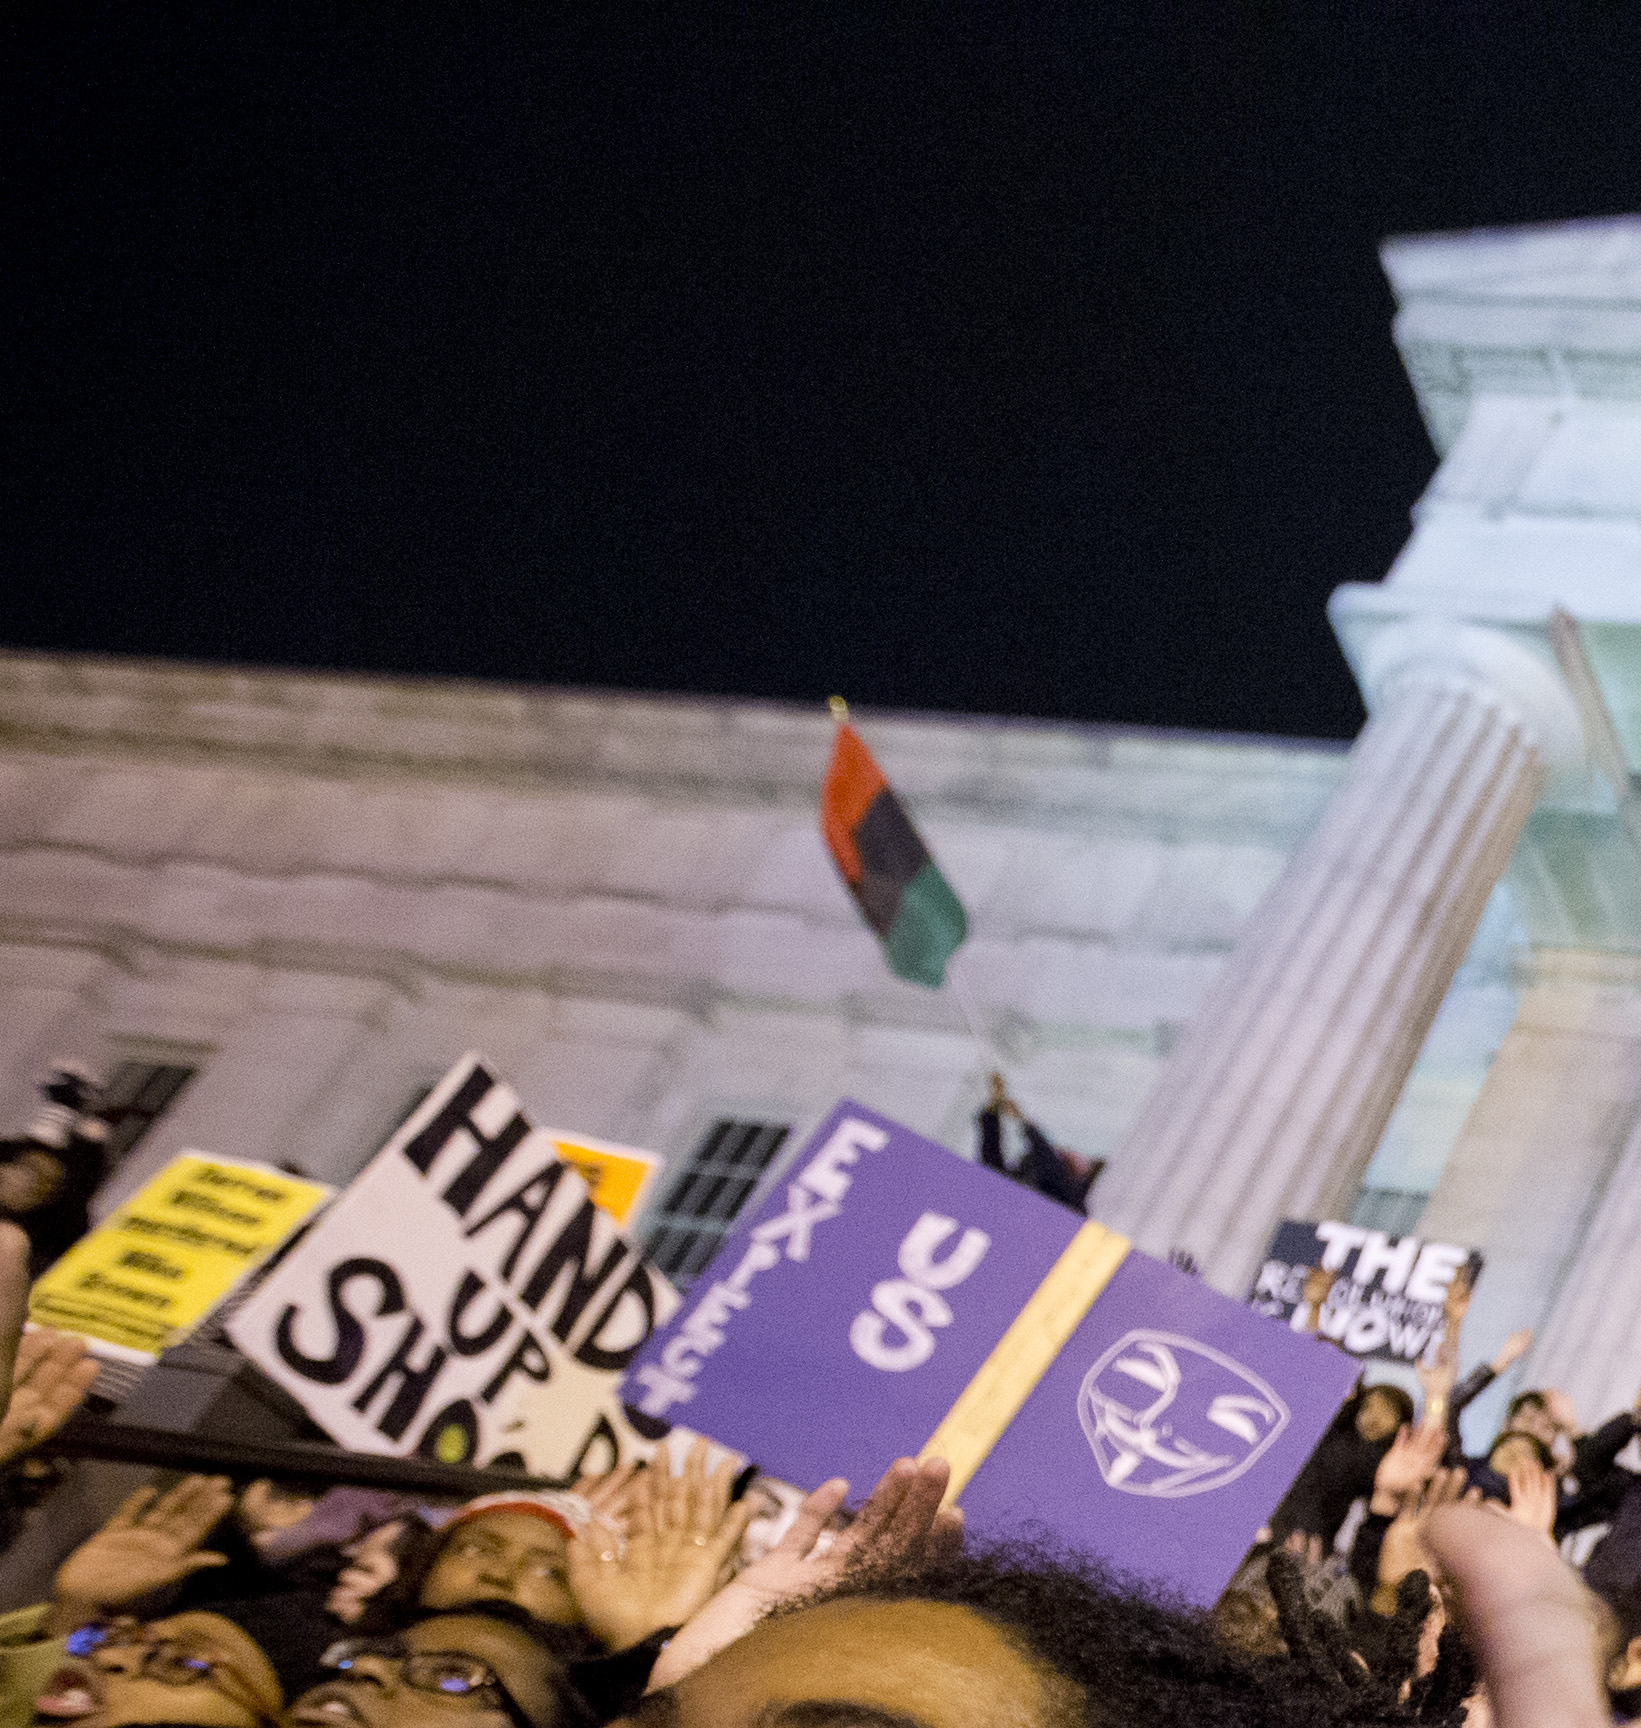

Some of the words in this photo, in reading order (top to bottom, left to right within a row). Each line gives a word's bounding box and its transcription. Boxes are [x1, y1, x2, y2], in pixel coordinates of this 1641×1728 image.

[634, 1115, 891, 1419] EXPECT
[849, 1211, 992, 1372] US
[1315, 1219, 1469, 1304] THE
